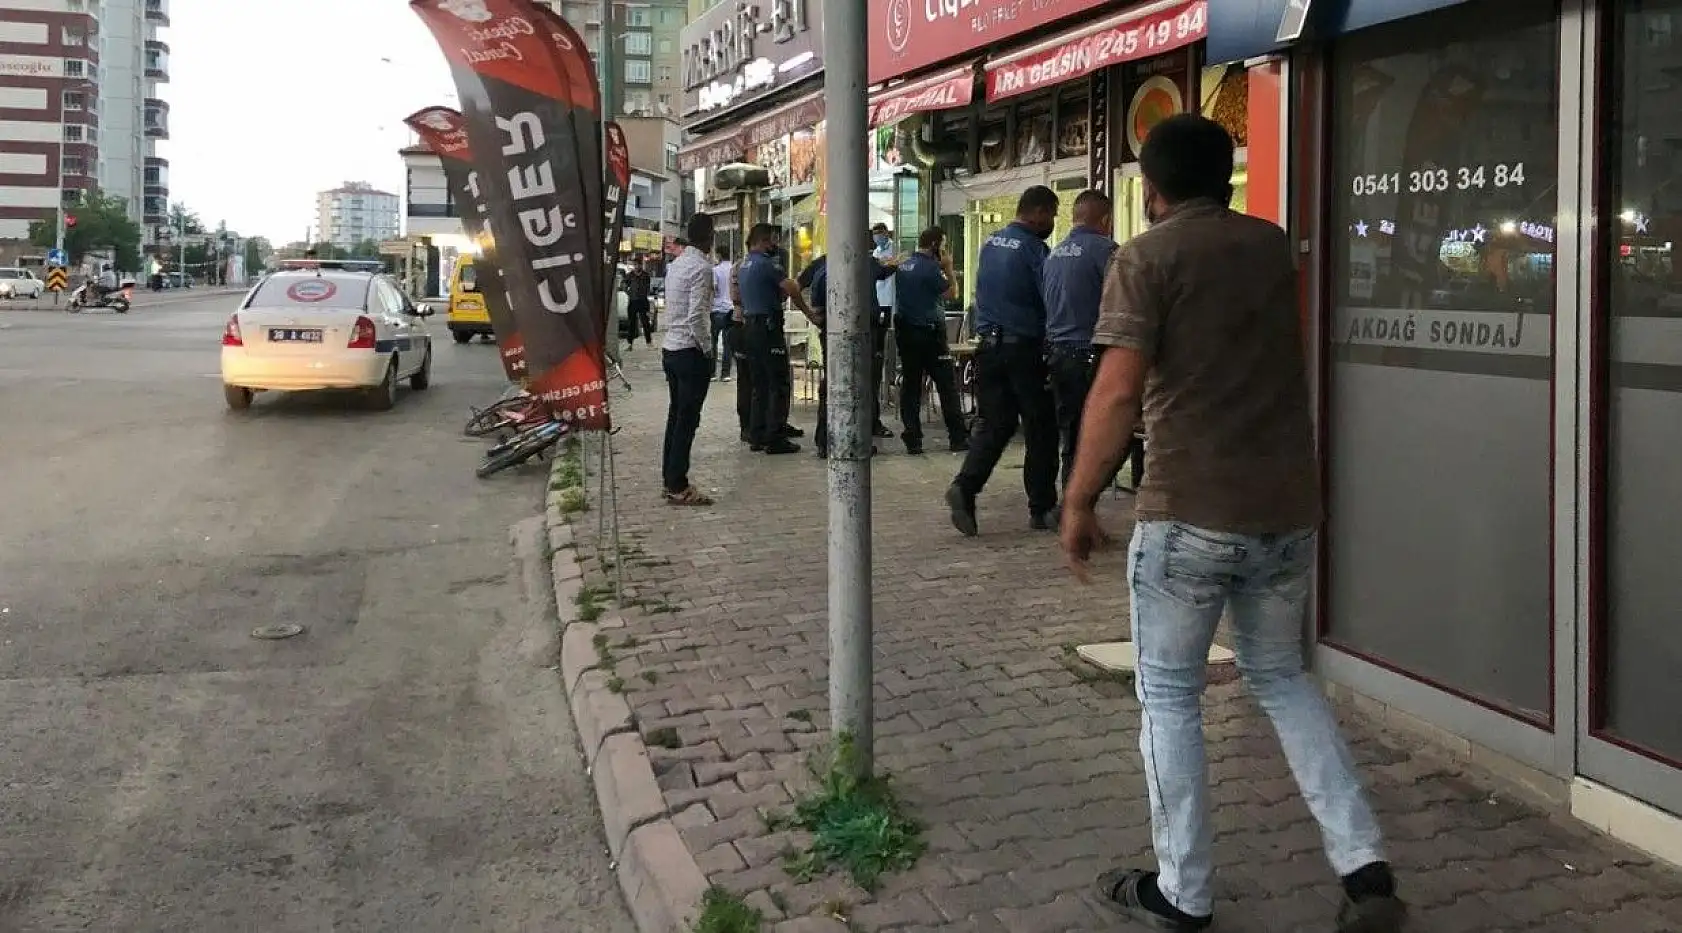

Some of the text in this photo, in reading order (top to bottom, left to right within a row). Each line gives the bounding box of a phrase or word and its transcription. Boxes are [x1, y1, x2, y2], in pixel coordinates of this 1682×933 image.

[994, 69, 1024, 95] ARA
[1098, 30, 1138, 59] 245
[1146, 21, 1171, 49] 19
[1177, 7, 1203, 38] 94
[1352, 163, 1525, 196] 0541 303 34 84
[1348, 312, 1523, 349] AKDAĞ SONDAJ
